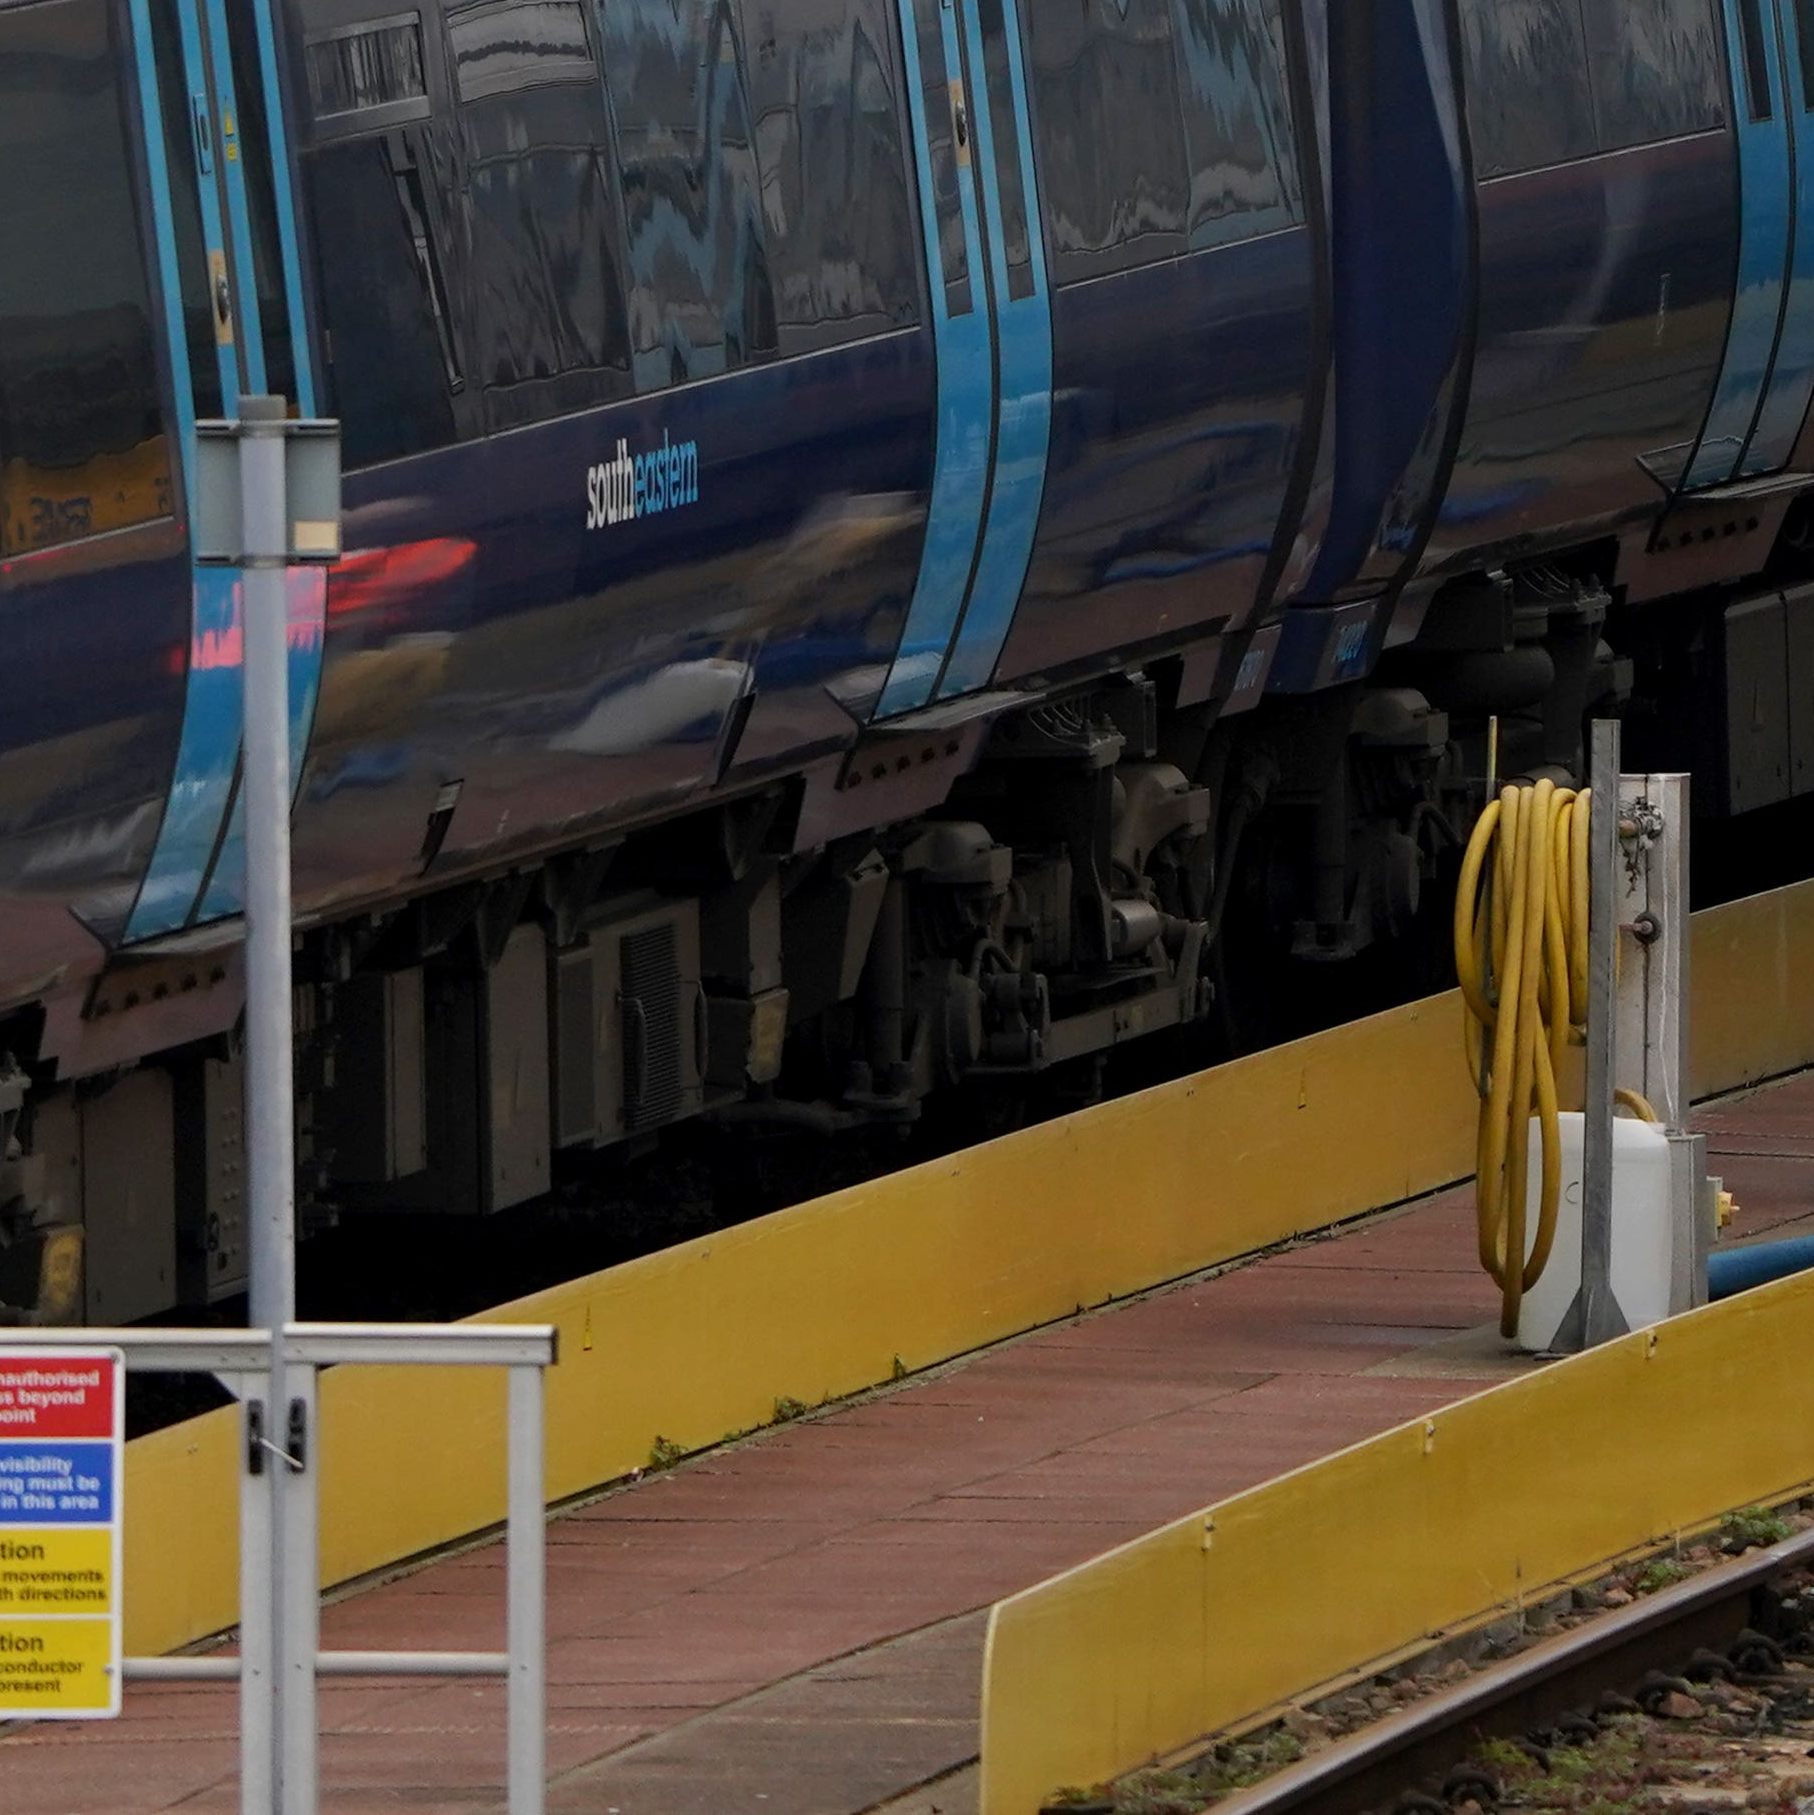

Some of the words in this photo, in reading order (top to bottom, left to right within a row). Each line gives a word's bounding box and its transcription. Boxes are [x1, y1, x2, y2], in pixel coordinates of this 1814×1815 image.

[586, 427, 698, 529] southeastern
[18, 1388, 85, 1408] beyond
[29, 1477, 74, 1491] must
[76, 1475, 100, 1491] be
[1, 1493, 18, 1509] in
[22, 1493, 56, 1509] this
[59, 1495, 99, 1509] area
[2, 1569, 104, 1582] movements
[20, 1586, 106, 1602] directions
